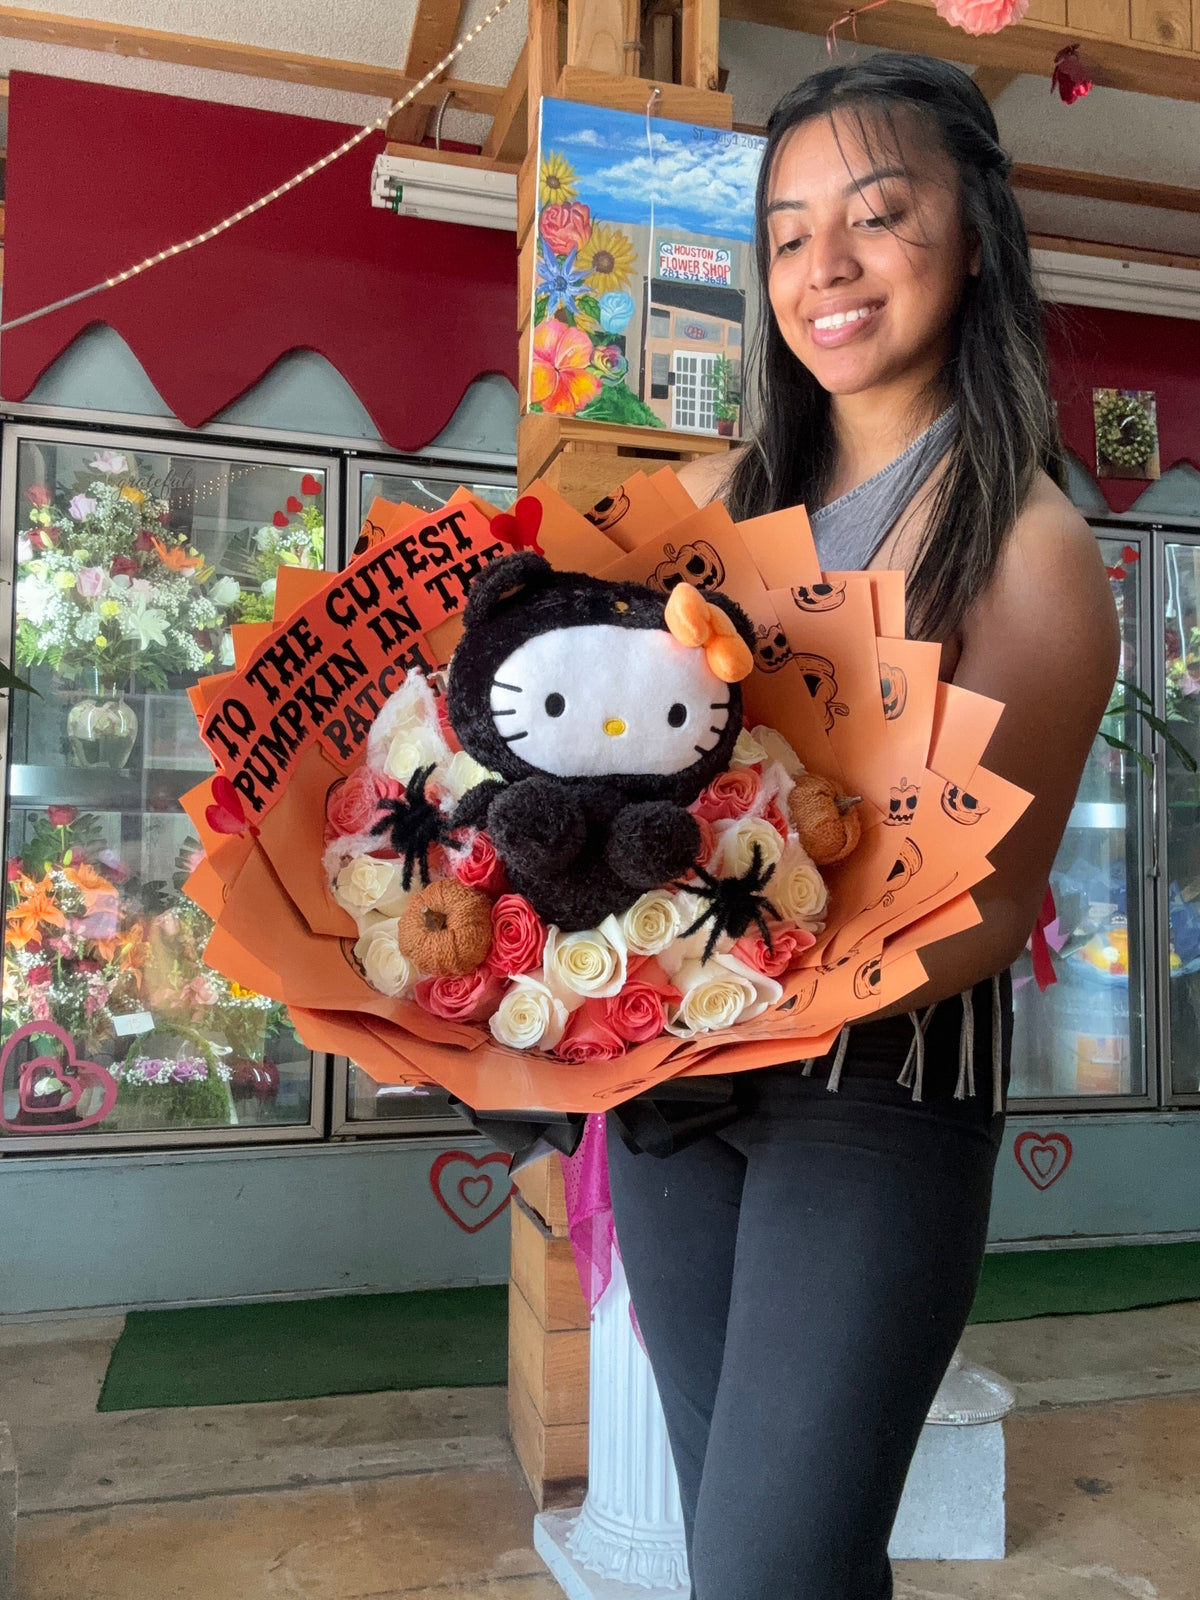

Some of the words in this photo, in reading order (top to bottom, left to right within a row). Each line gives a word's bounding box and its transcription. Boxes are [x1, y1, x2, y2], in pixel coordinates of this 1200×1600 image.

[660, 256, 700, 274] FLOWER
[702, 262, 731, 278] SHOP
[674, 245, 714, 261] HOUSTON
[111, 468, 194, 502] grateful
[206, 699, 257, 762] TO
[245, 617, 323, 705] THE
[325, 510, 474, 629] CUTEST
[233, 639, 370, 812] PUMPKIN
[366, 595, 422, 655] IN
